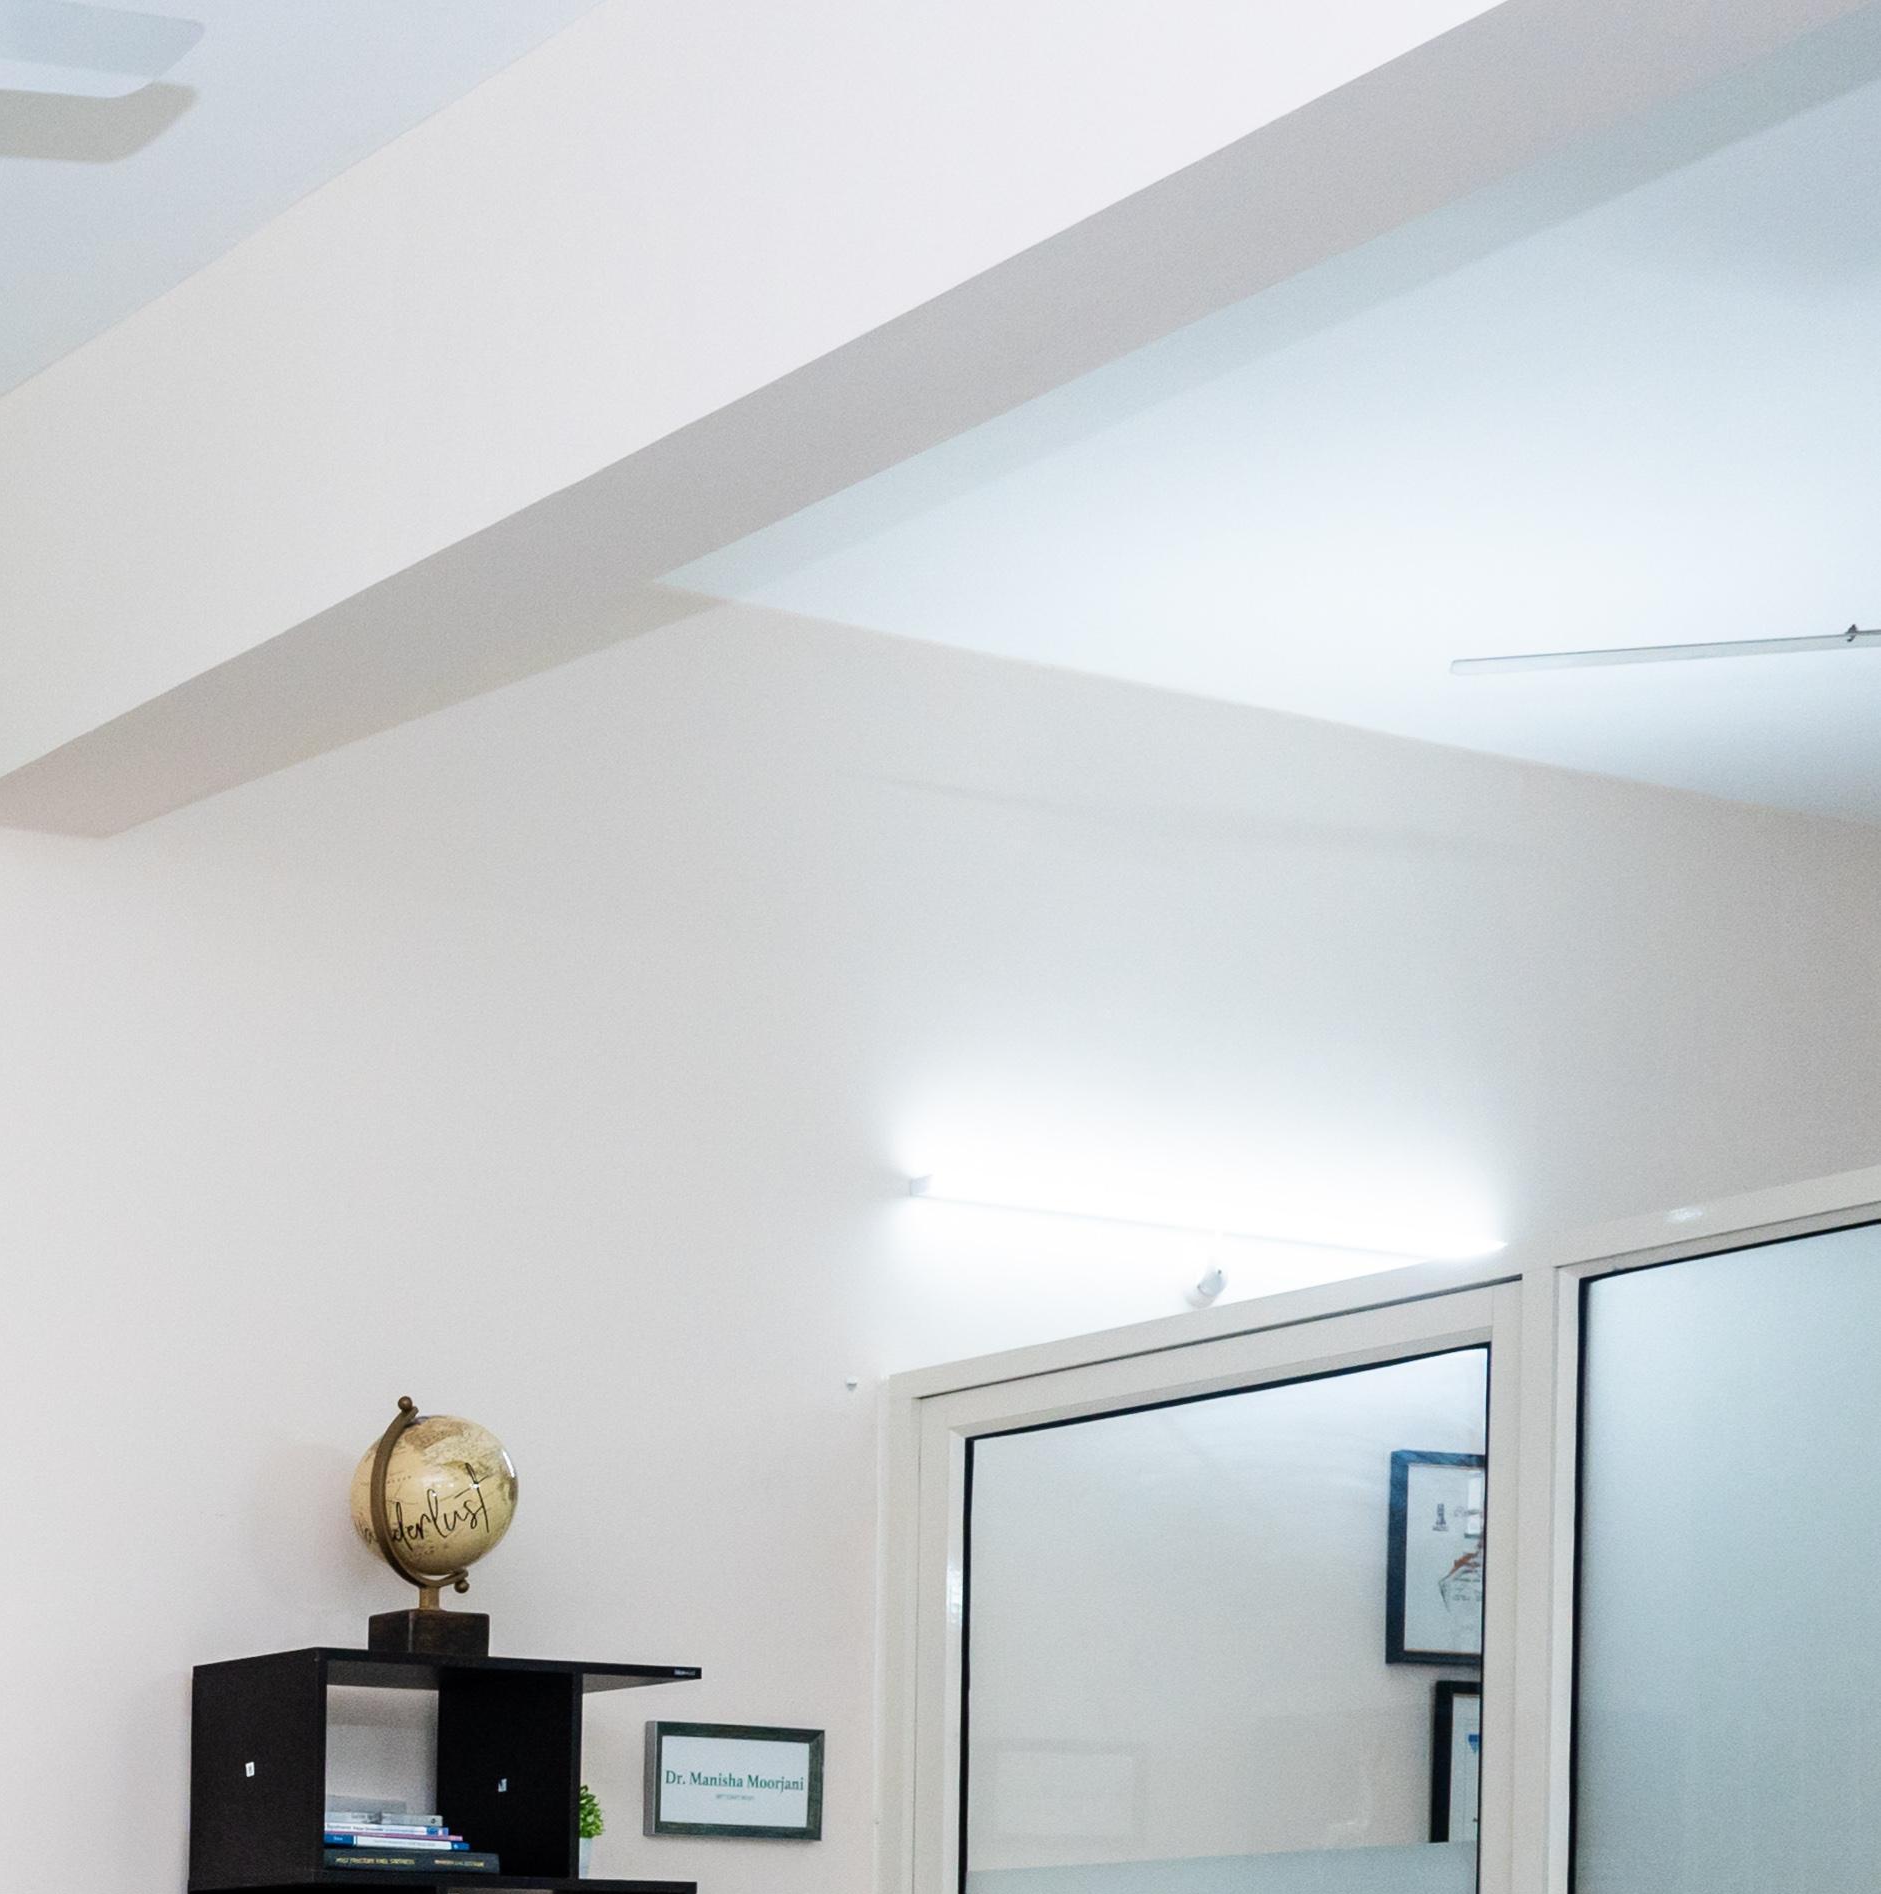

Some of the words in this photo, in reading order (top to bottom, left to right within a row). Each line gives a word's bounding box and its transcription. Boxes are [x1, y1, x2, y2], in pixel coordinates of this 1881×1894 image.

[354, 1463, 490, 1551] aderlust
[665, 1770, 686, 1785] Dr.
[689, 1771, 744, 1788] Manisha
[747, 1774, 804, 1793] Moorjani
